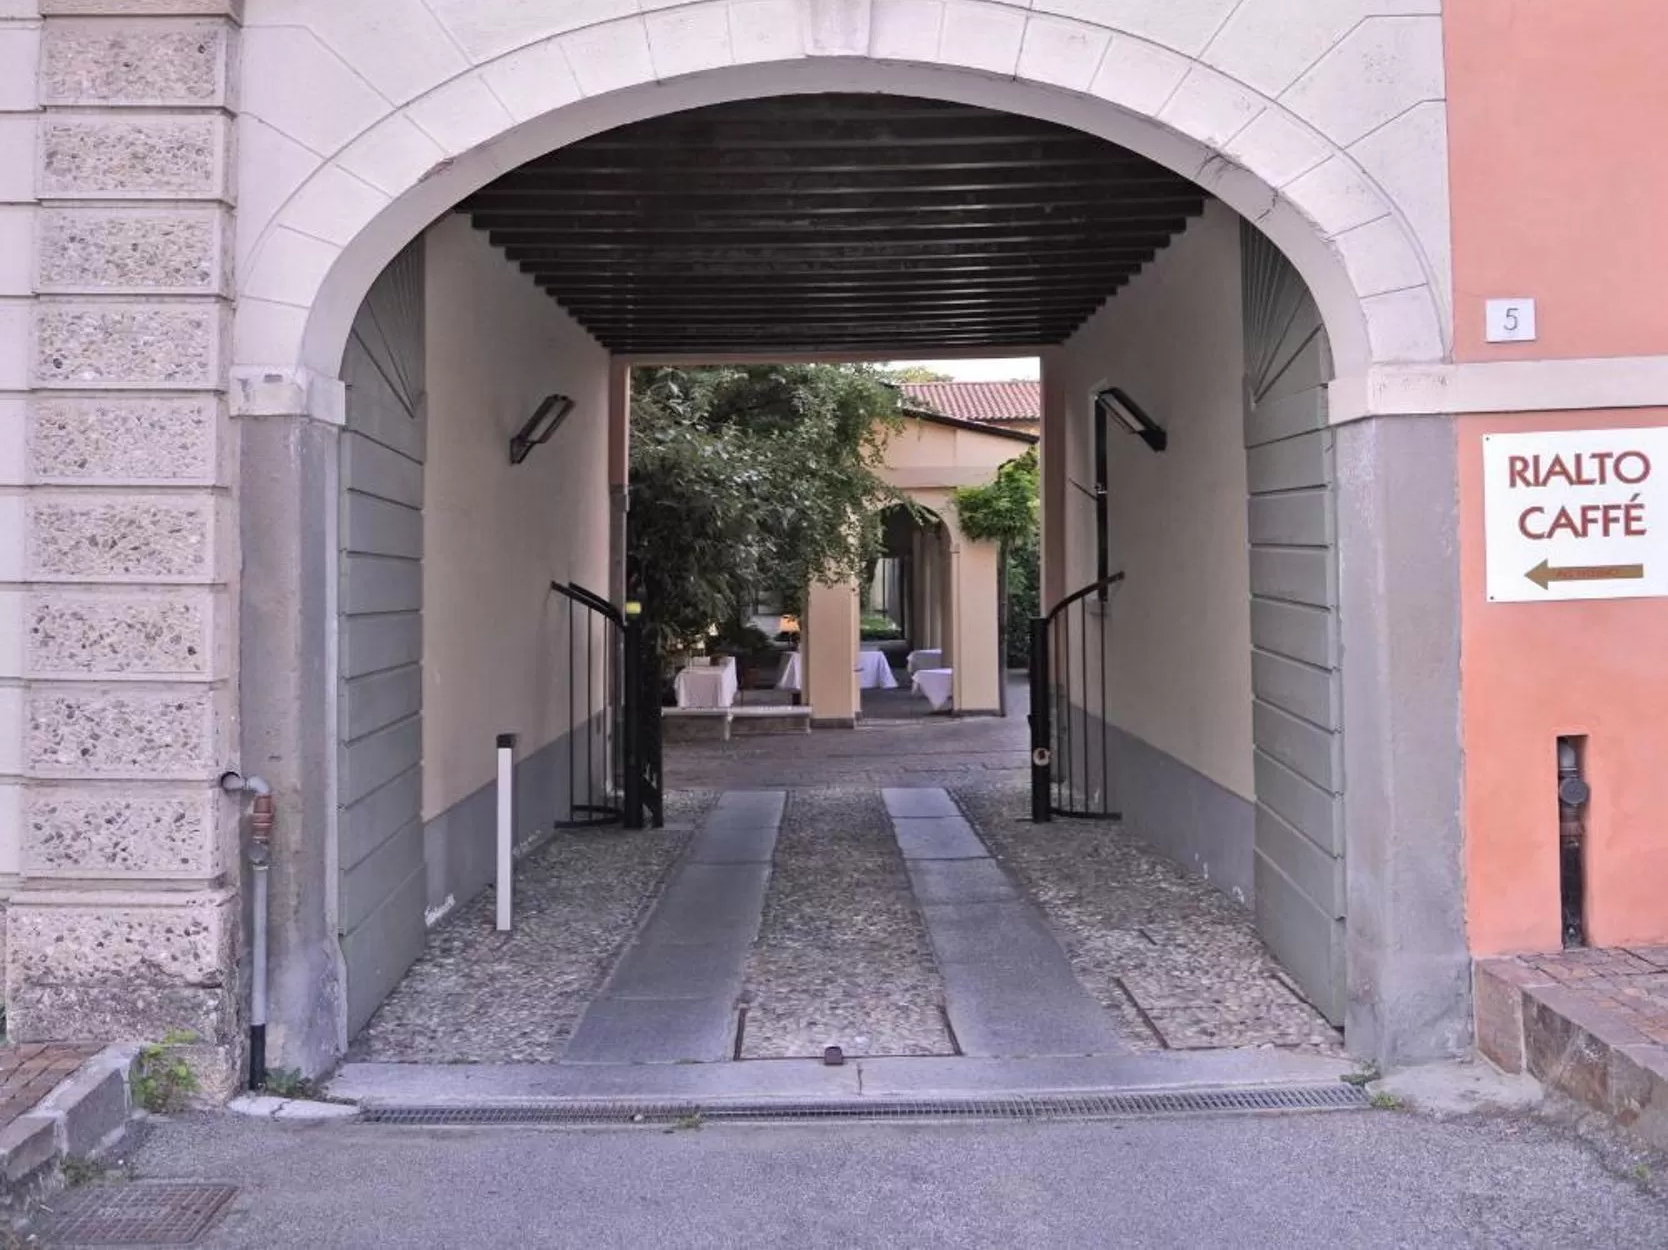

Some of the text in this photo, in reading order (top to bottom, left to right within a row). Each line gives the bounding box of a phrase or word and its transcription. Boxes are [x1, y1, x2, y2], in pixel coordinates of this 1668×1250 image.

[1503, 307, 1519, 331] 5
[1508, 450, 1652, 489] RIALTO
[1518, 492, 1648, 540] CAFFÉ
